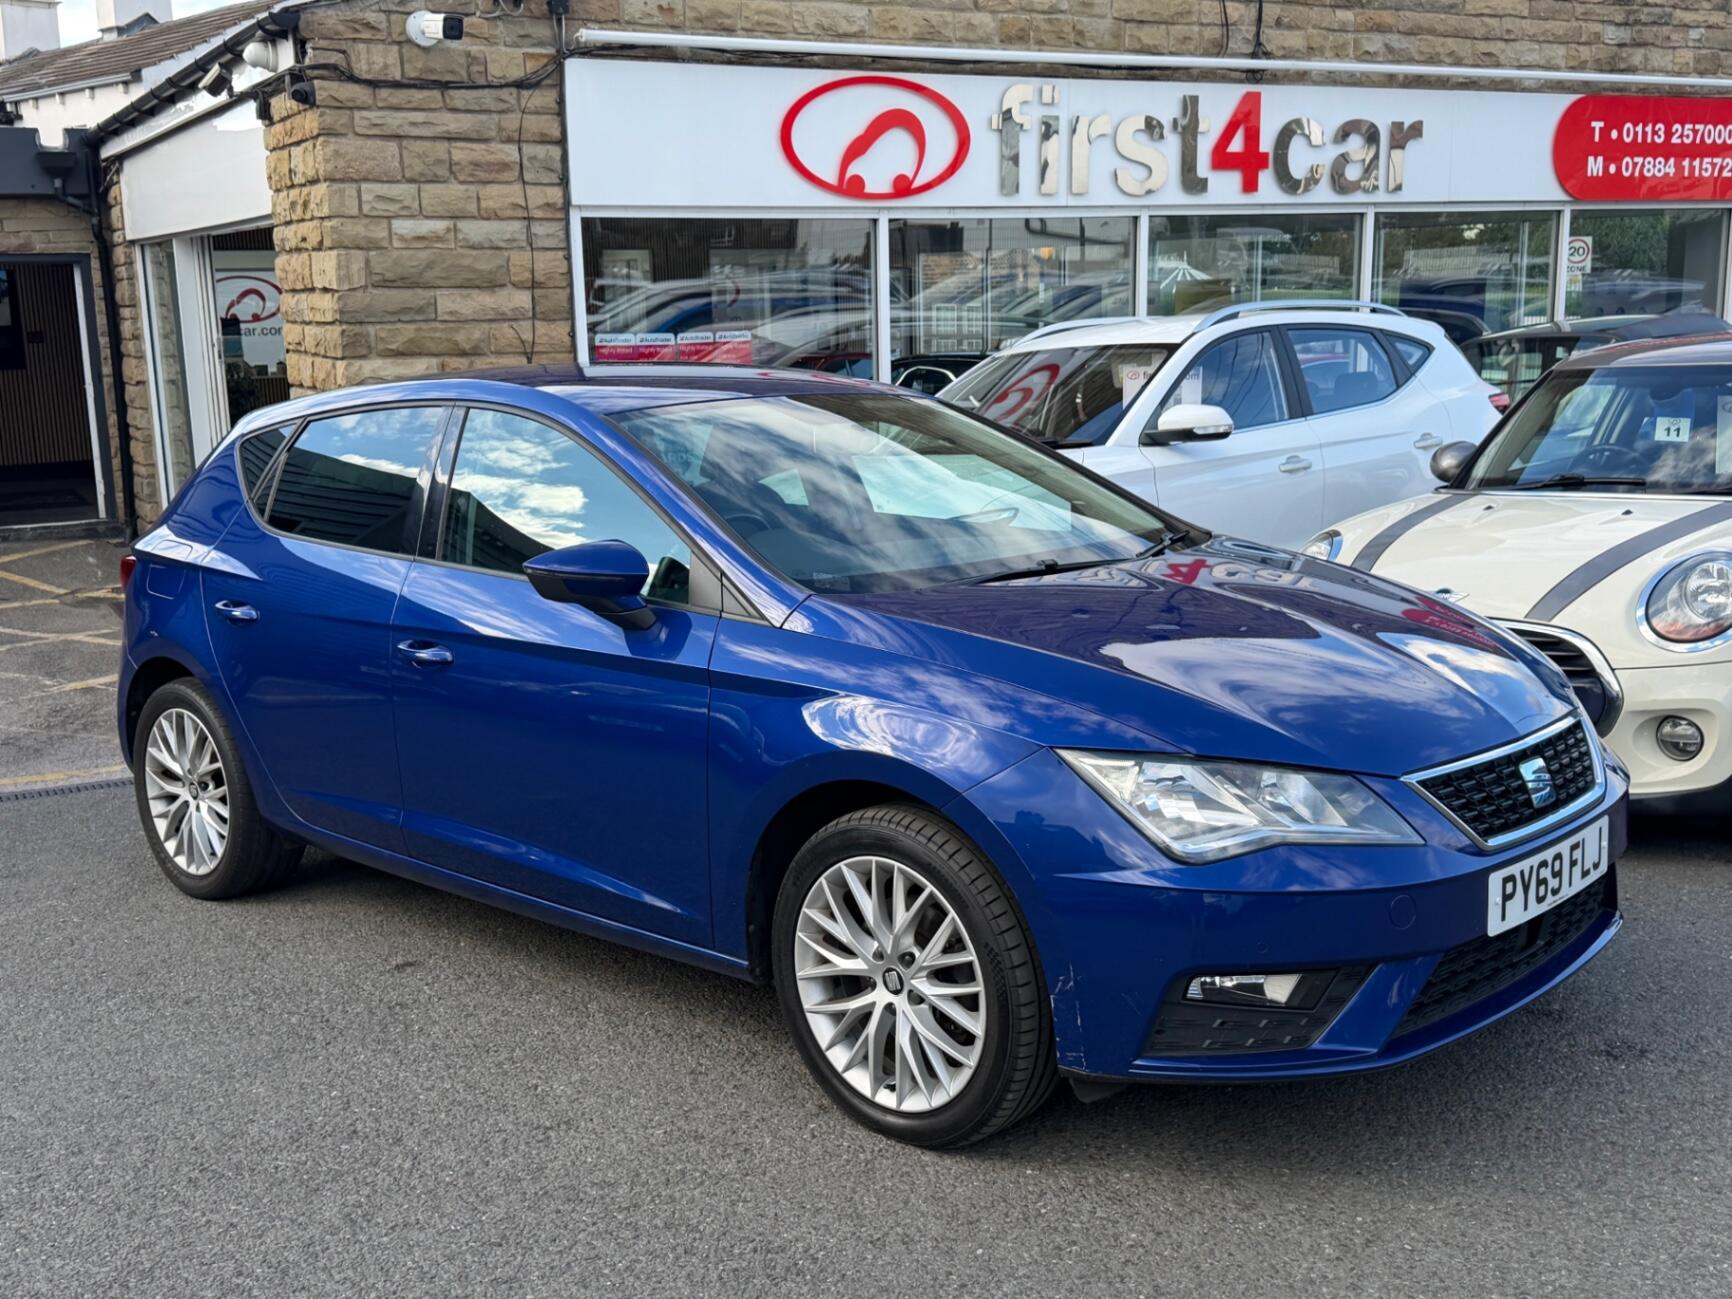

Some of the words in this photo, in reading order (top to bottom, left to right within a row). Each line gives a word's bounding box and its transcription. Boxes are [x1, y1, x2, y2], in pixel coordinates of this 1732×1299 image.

[991, 83, 1423, 196] first4car
[1591, 121, 1604, 142] T
[1623, 122, 1665, 143] 0113
[1587, 156, 1603, 177] M
[1622, 157, 1675, 177] 07884
[1682, 157, 1732, 177] 11572
[1569, 246, 1585, 257] 20
[1664, 426, 1681, 438] 11
[1501, 851, 1563, 922] PY69
[1568, 826, 1602, 888] FLJ
